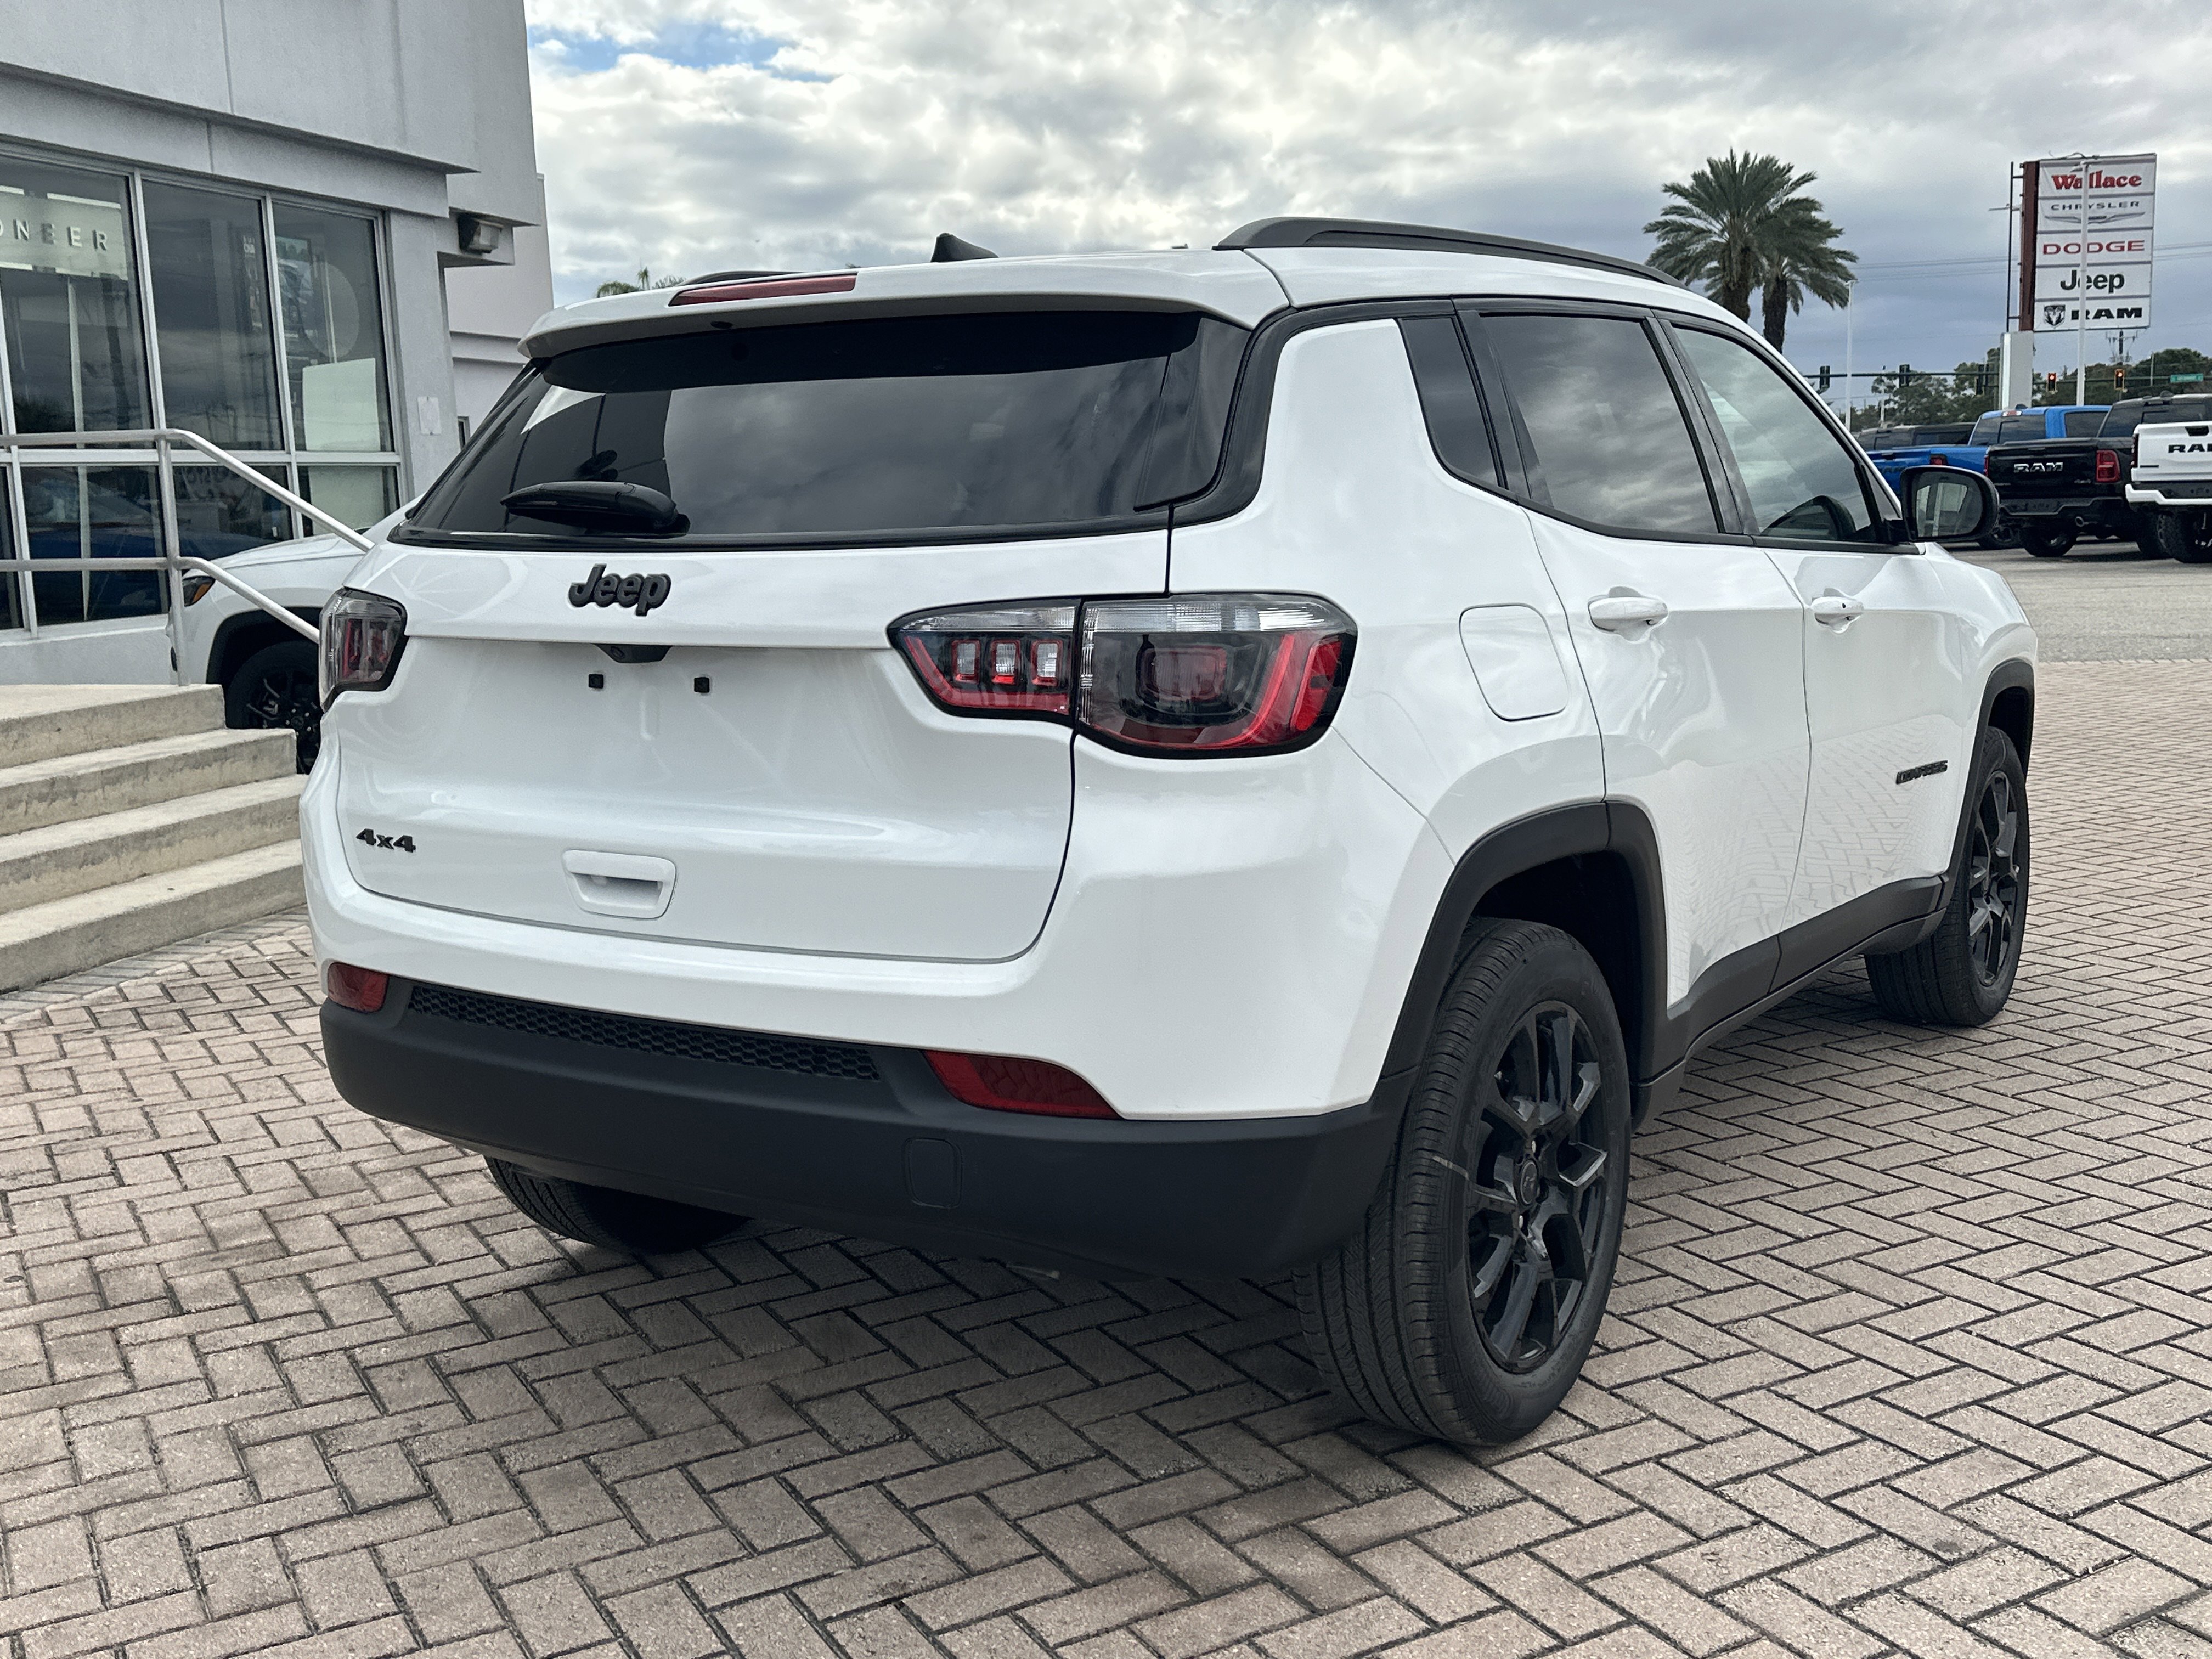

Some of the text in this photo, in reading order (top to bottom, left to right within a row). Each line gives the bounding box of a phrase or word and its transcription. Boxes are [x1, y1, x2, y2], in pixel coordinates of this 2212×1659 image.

[2051, 170, 2142, 190] Wallace
[2050, 201, 2140, 211] CHRYSLER
[2042, 240, 2145, 255] DODGE
[2070, 307, 2142, 320] RAM
[2013, 462, 2063, 473] RAM
[568, 563, 672, 617] Jeep
[356, 828, 416, 853] 4x4
